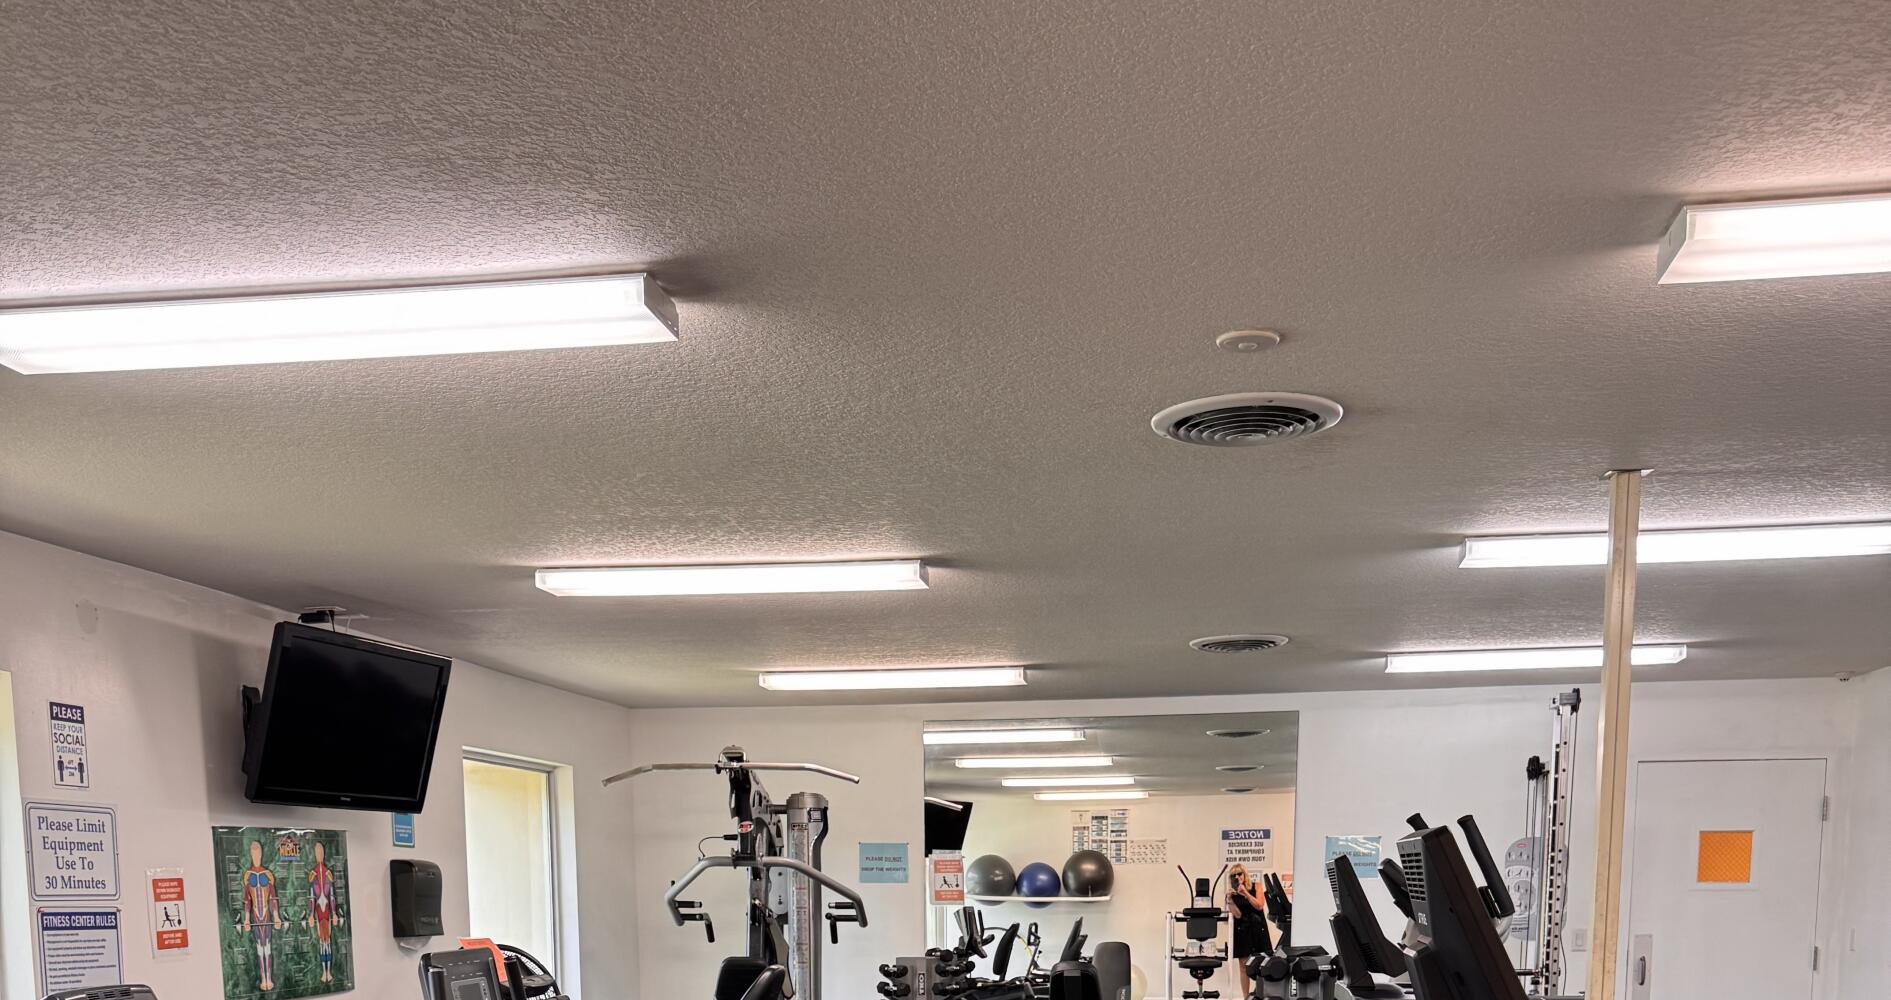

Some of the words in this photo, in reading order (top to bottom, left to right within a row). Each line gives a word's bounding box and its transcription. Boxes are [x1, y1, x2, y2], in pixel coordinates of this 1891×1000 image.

[52, 705, 82, 721] PLEASE
[53, 723, 66, 732] KEEP
[68, 725, 83, 734] YOUR
[53, 732, 85, 747] SOCIAL
[56, 745, 83, 756] DISTANCE
[37, 815, 73, 832] Please
[76, 818, 106, 833] Limit
[42, 836, 104, 855] Equipment
[55, 856, 76, 870] Use
[79, 856, 94, 870] To
[45, 876, 57, 889] 30
[61, 875, 106, 889] Minutes
[43, 915, 70, 928] FITNESS
[71, 915, 95, 927] CENTER
[96, 915, 116, 926] RULES
